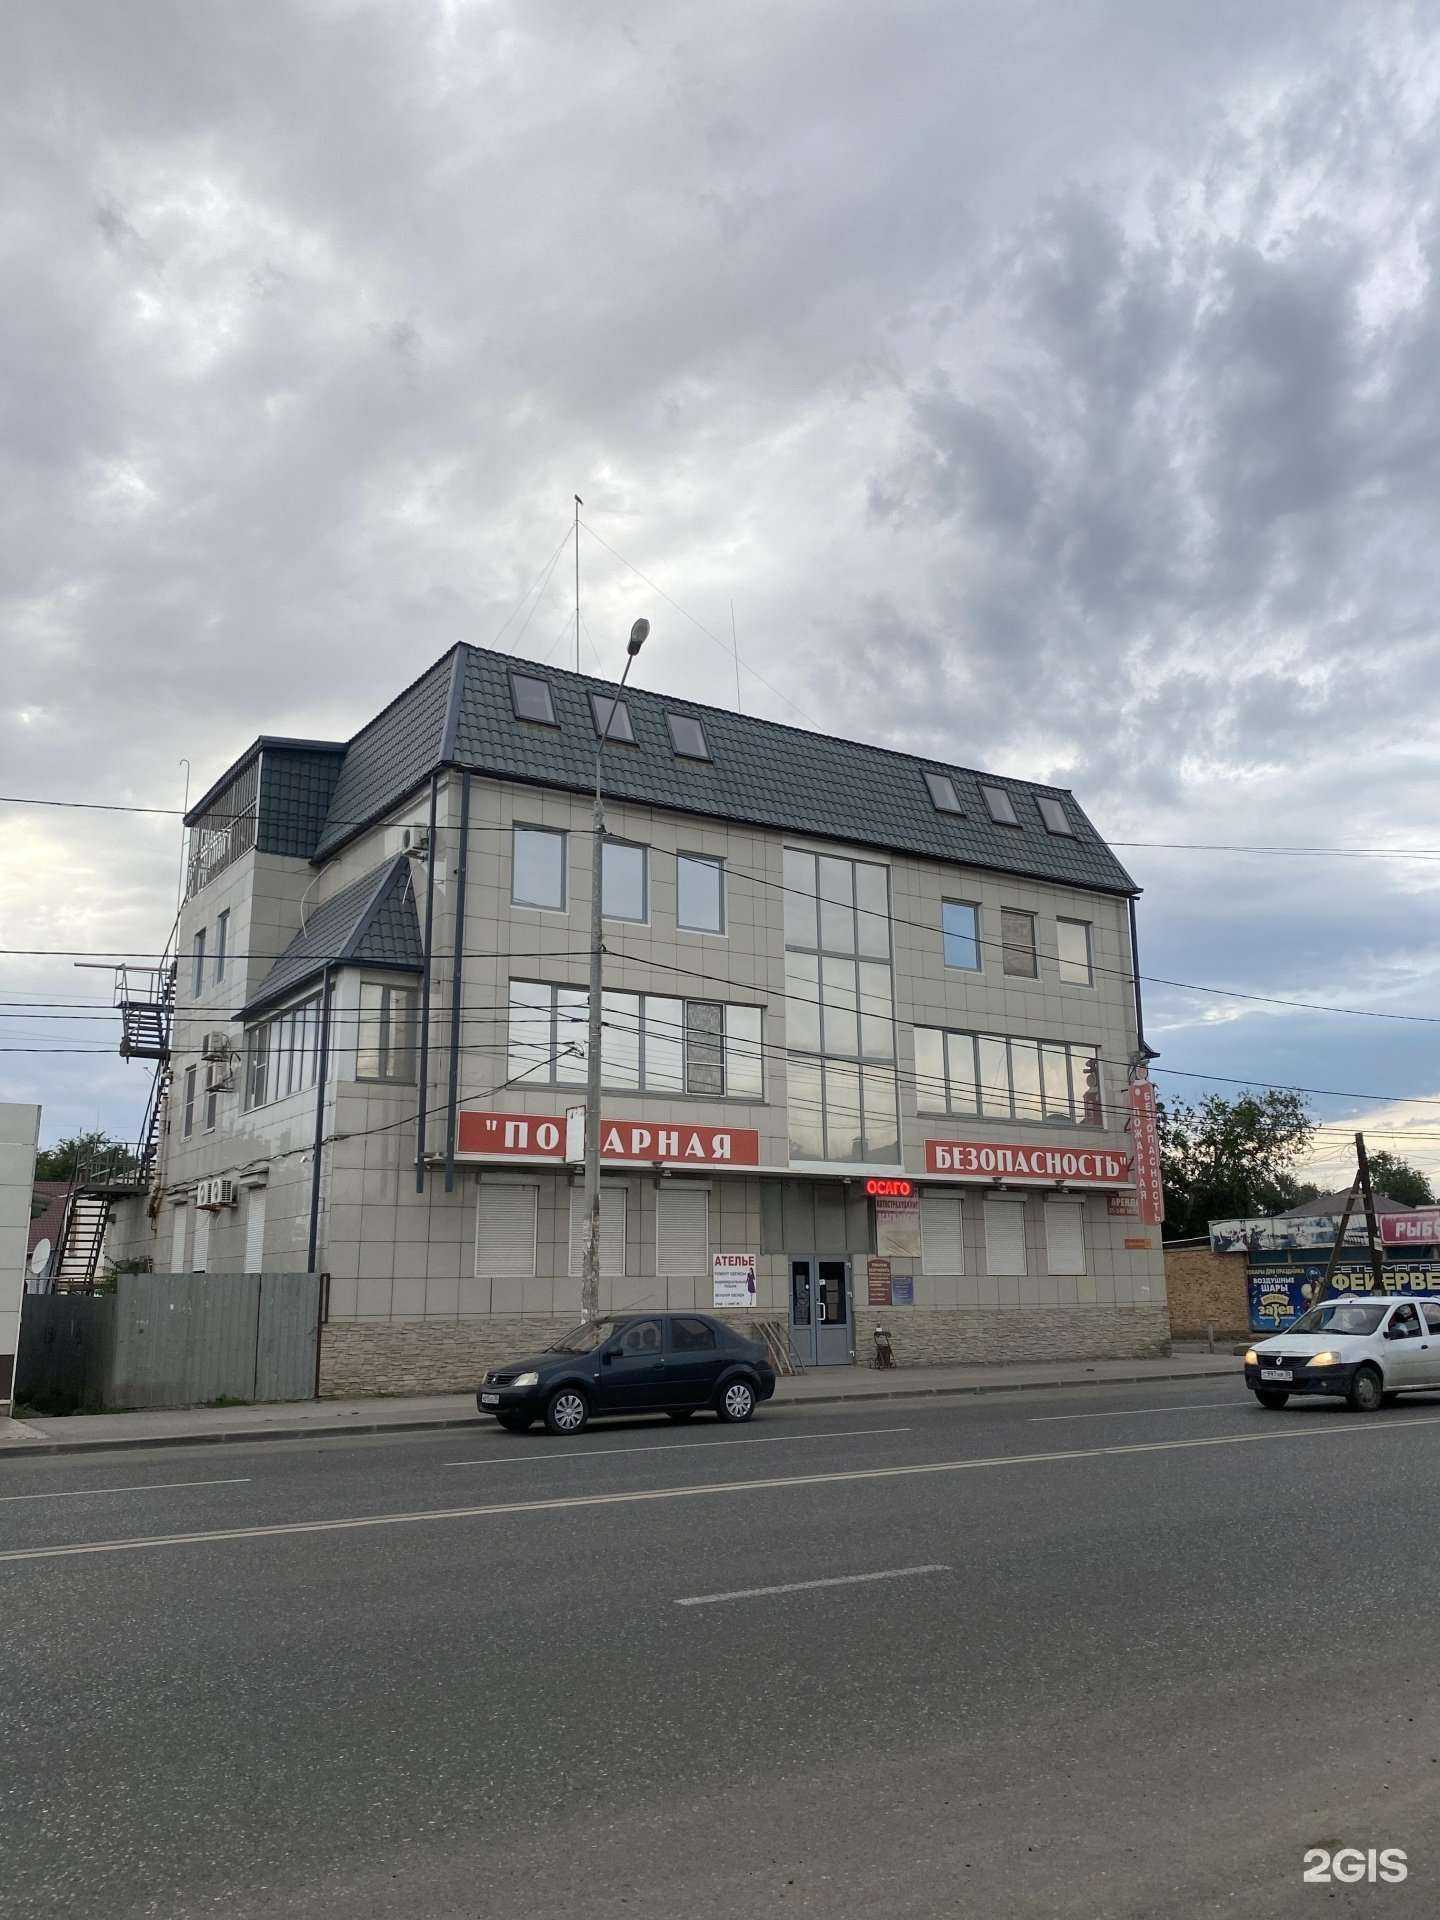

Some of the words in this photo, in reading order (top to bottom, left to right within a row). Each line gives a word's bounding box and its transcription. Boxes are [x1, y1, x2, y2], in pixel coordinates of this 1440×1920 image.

[485, 1119, 732, 1159] "ПОАРНАЯ
[935, 1145, 1127, 1177] БЕЗОПАСНОСТЬ"
[866, 1180, 911, 1196] ОСАГО
[715, 1256, 755, 1266] АТЕЛЬЕ
[1261, 1284, 1288, 1292] ШАРЫ
